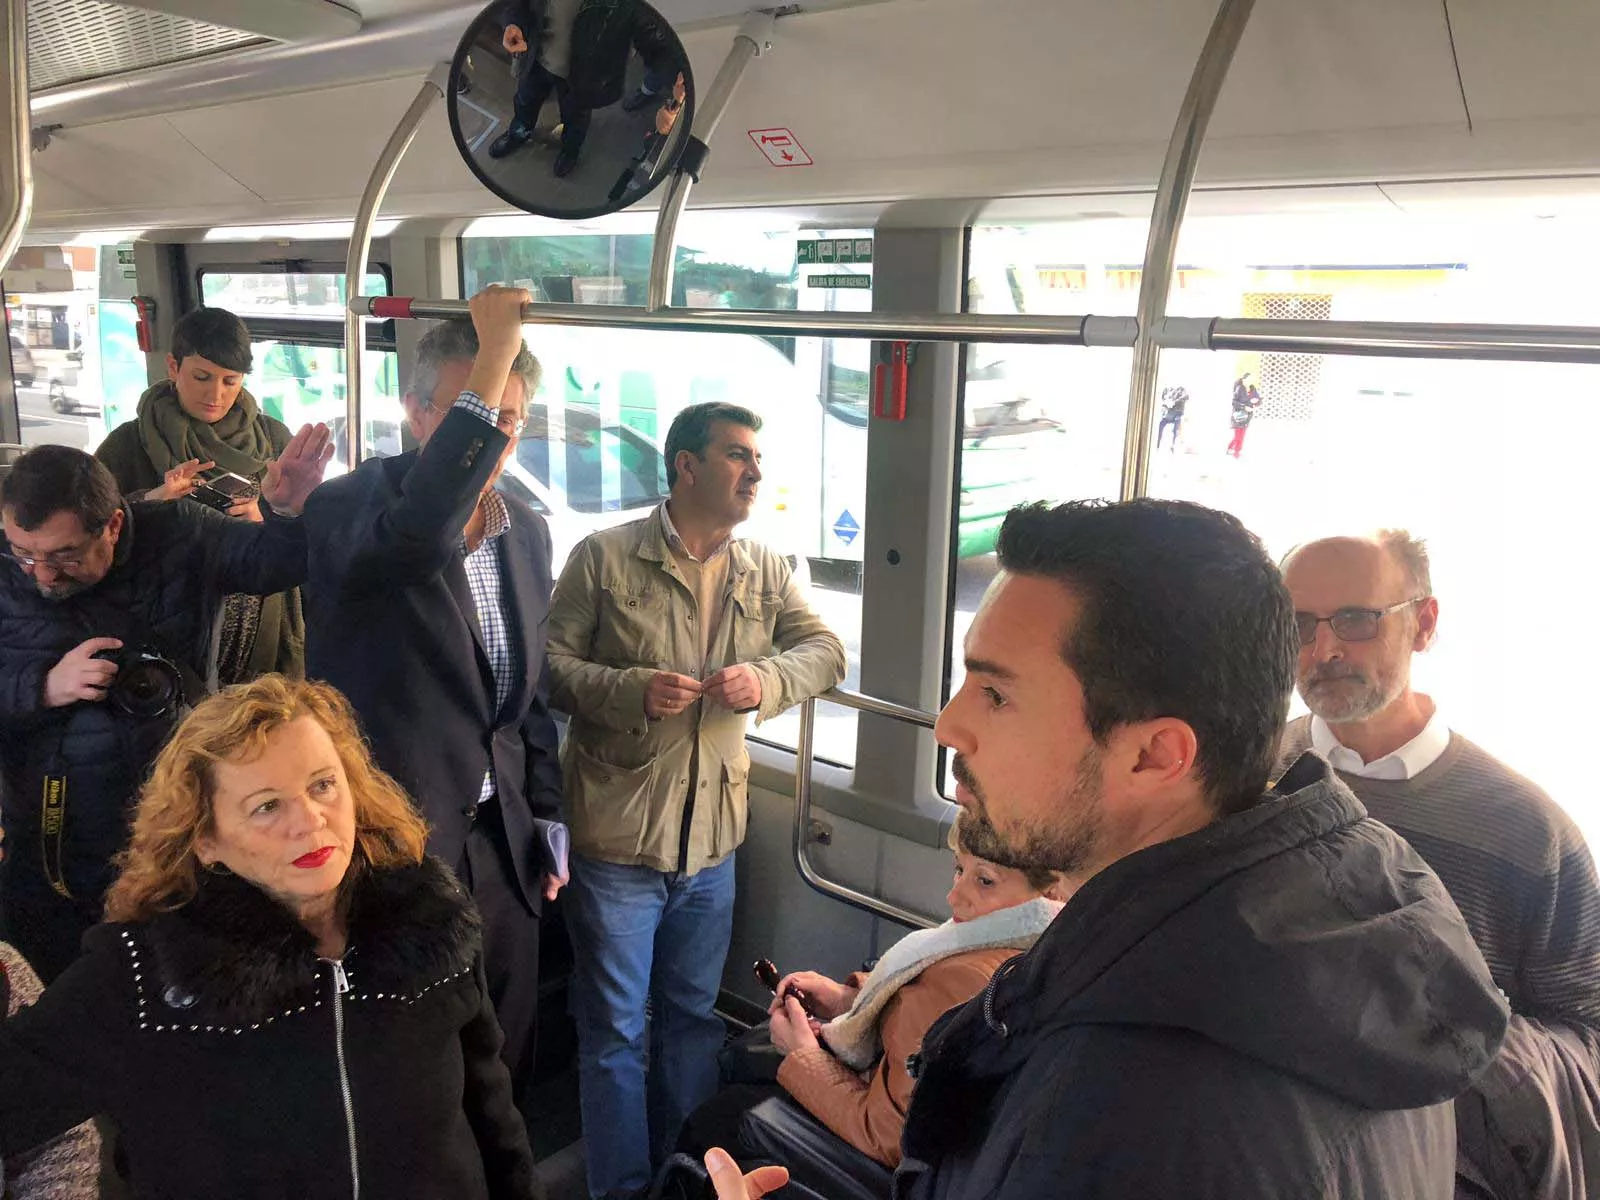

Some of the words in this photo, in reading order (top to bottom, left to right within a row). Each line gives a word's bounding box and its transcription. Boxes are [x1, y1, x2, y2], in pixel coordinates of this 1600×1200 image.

[809, 277, 828, 287] SALIDA
[828, 277, 835, 287] DE
[835, 277, 869, 287] EMERGENCIA
[49, 780, 60, 805] Nikon
